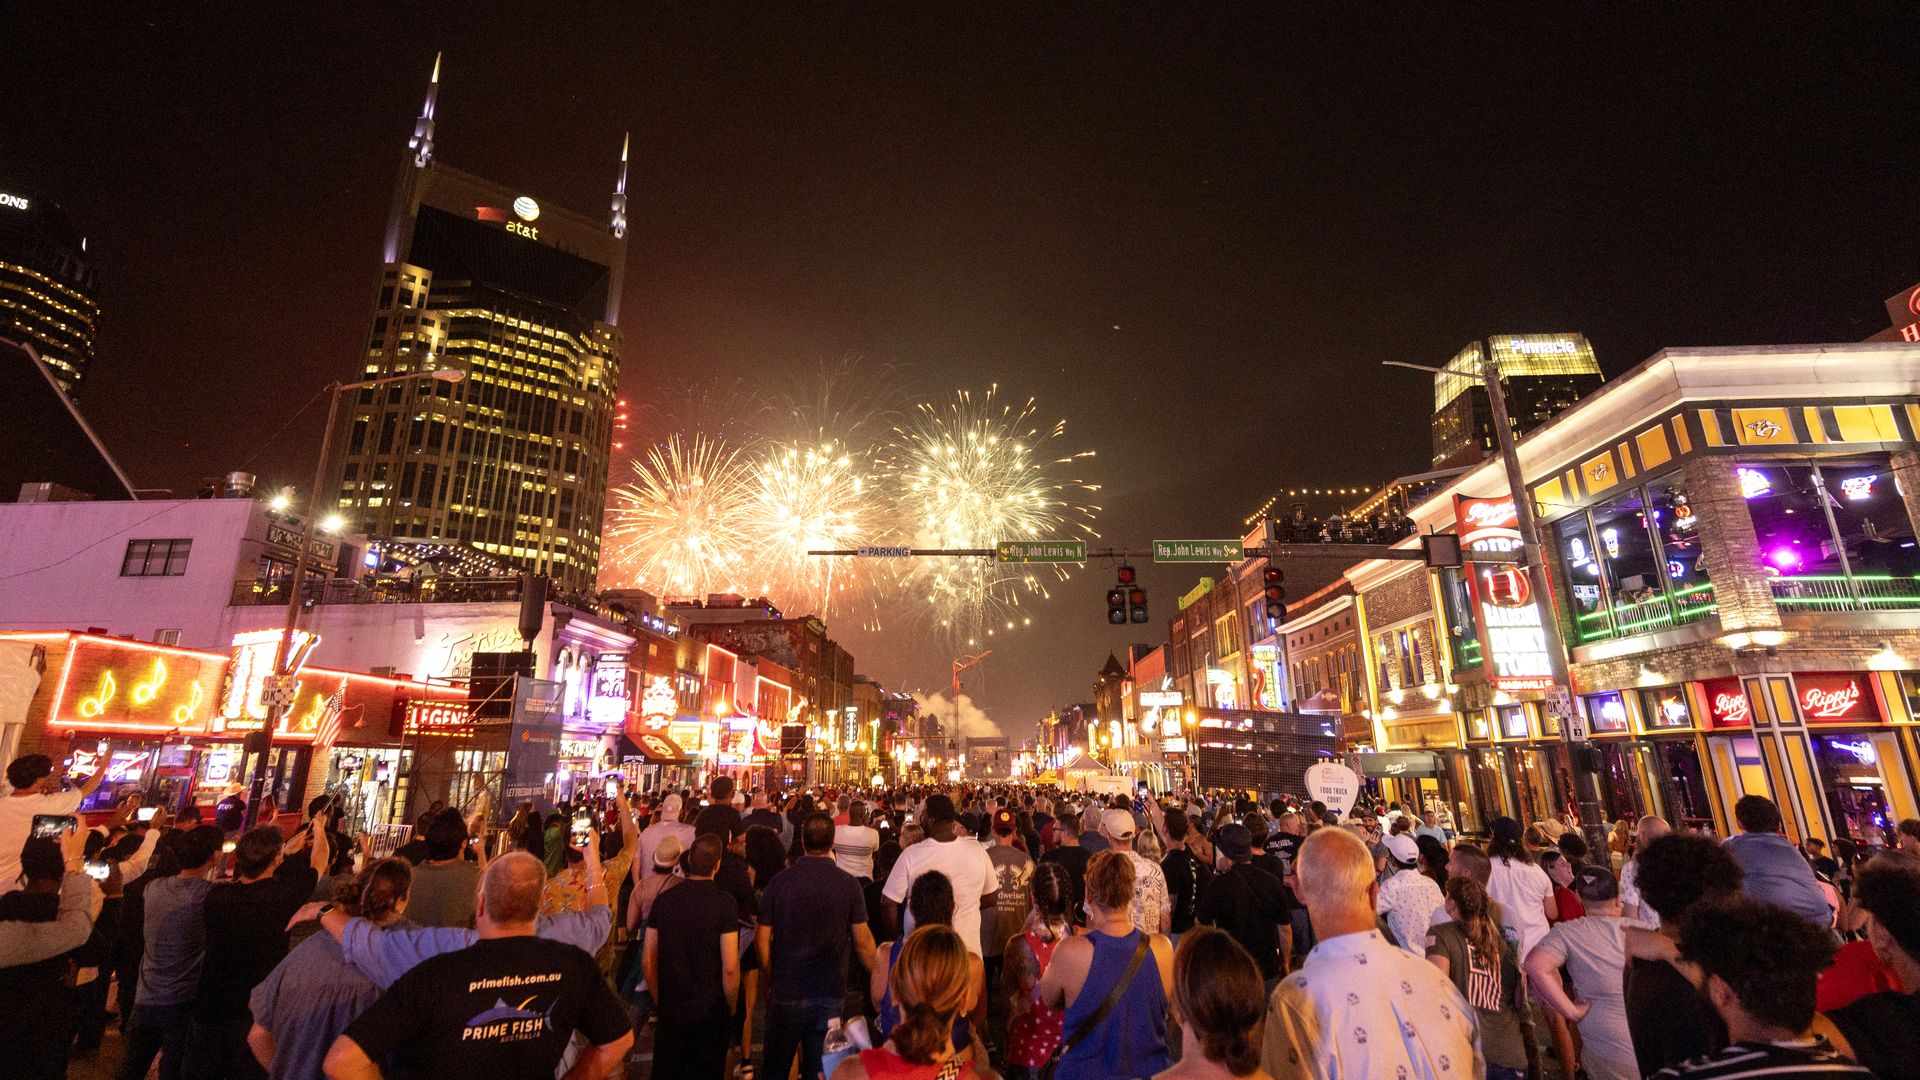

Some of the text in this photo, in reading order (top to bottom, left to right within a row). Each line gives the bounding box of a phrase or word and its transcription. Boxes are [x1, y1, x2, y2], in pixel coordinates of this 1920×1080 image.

[506, 221, 539, 241] at&t
[1510, 338, 1576, 354] Pinnacle
[868, 547, 909, 557] PARKING
[1027, 543, 1042, 557] John
[1043, 544, 1064, 557] Lewis
[1076, 545, 1082, 558] N
[1158, 544, 1173, 558] Rep.
[1173, 543, 1190, 556] John
[1190, 543, 1211, 556] Lewis
[1802, 679, 1860, 711] Rippy's
[1385, 760, 1407, 773] Rippy's
[1320, 786, 1347, 795] FOOD TRUCK
[468, 972, 562, 993] primefish.com.au
[462, 1018, 543, 1041] PRIME FISH
[500, 1031, 541, 1043] AUSTRALIA
